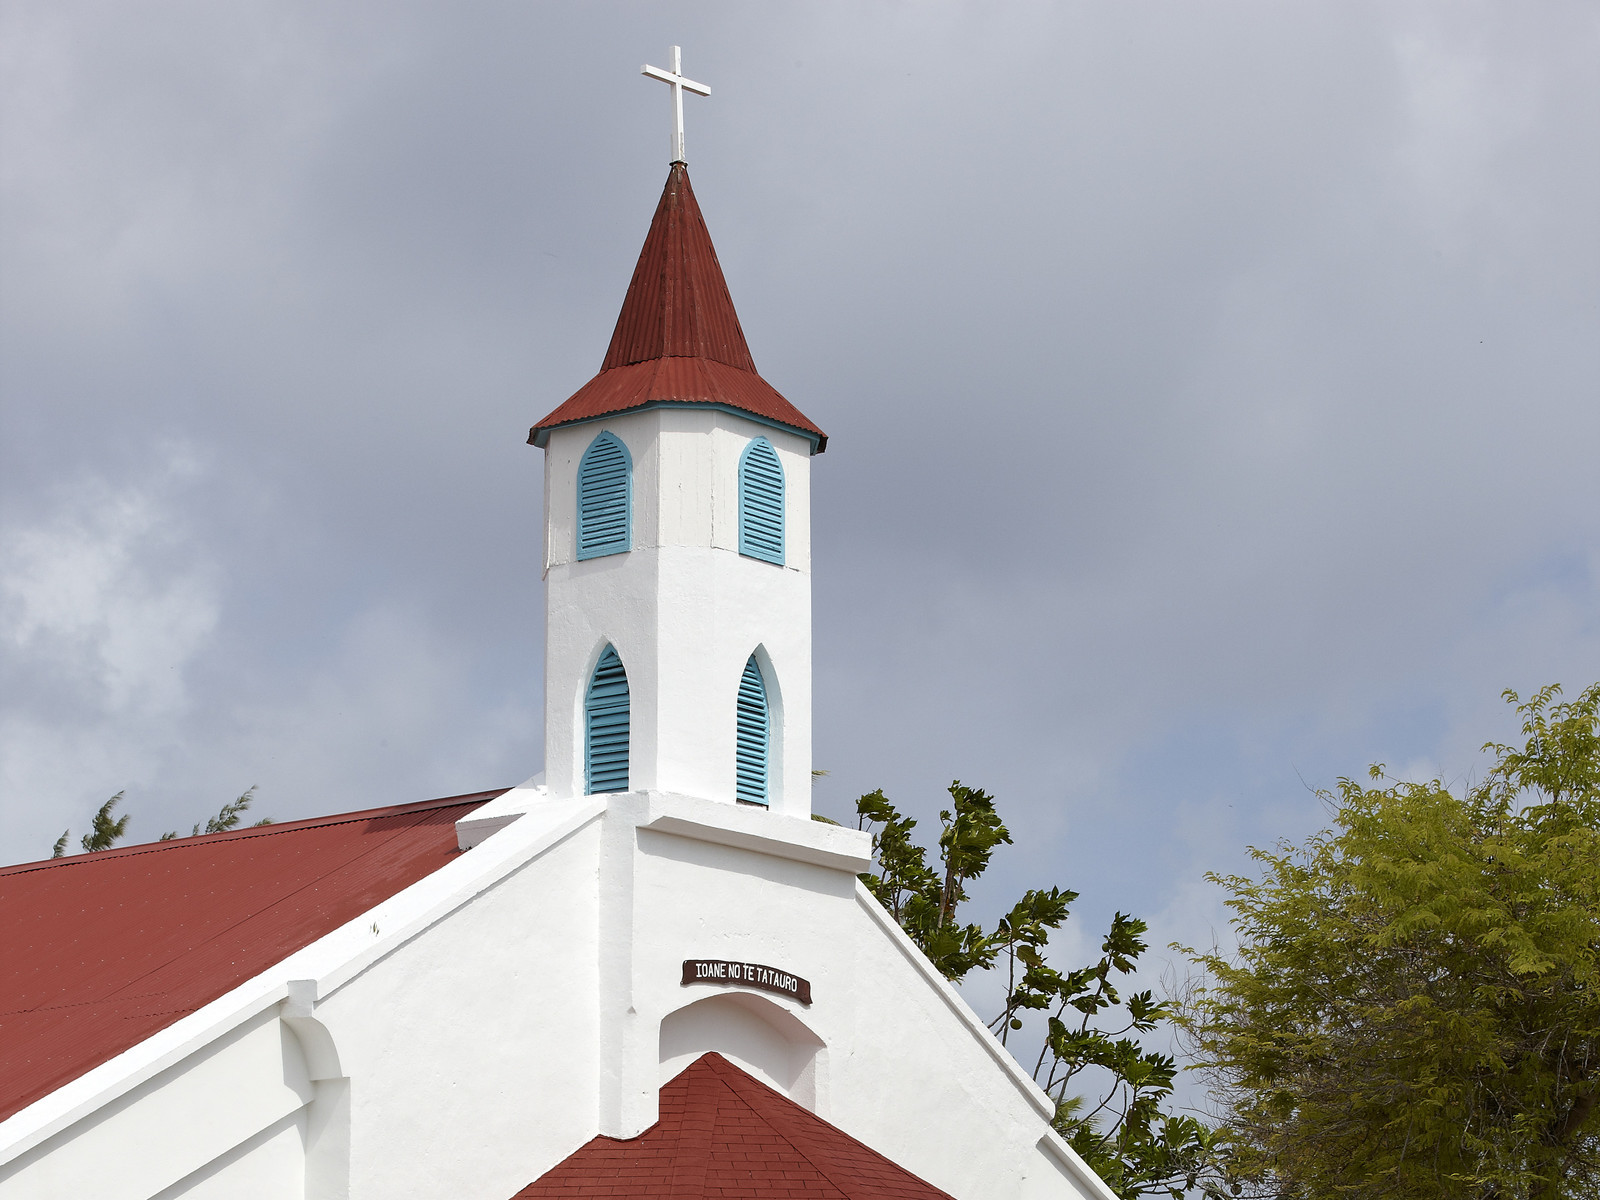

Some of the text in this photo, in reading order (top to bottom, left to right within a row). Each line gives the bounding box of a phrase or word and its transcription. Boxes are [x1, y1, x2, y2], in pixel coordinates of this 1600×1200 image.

[695, 963, 798, 992] IOANE NO TE TATAURO
